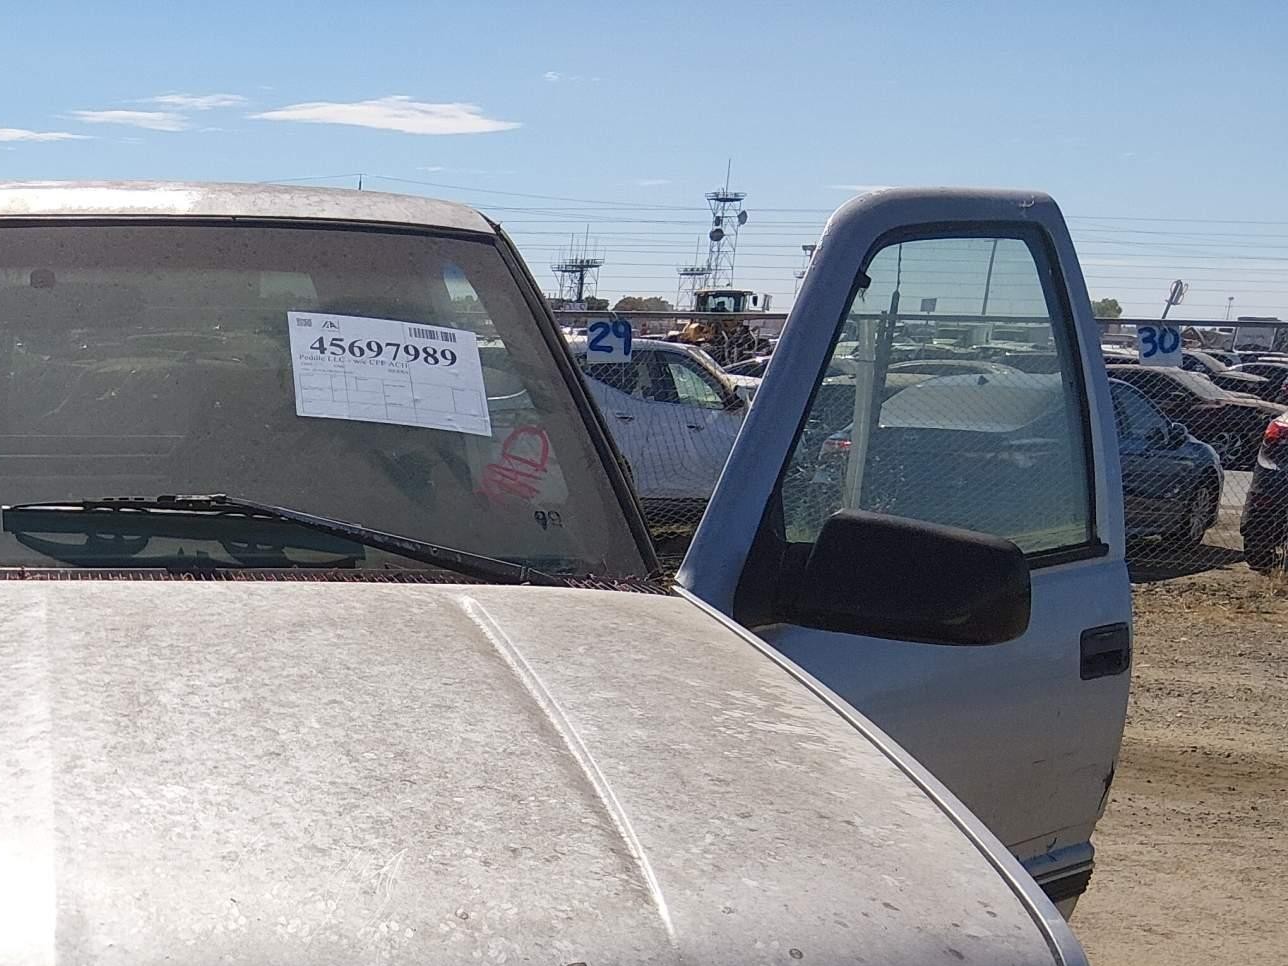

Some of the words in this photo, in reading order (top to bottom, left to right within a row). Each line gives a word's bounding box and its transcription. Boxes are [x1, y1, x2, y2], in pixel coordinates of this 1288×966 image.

[309, 335, 457, 367] 45697989
[589, 320, 632, 355] 29
[1138, 326, 1180, 358] 30
